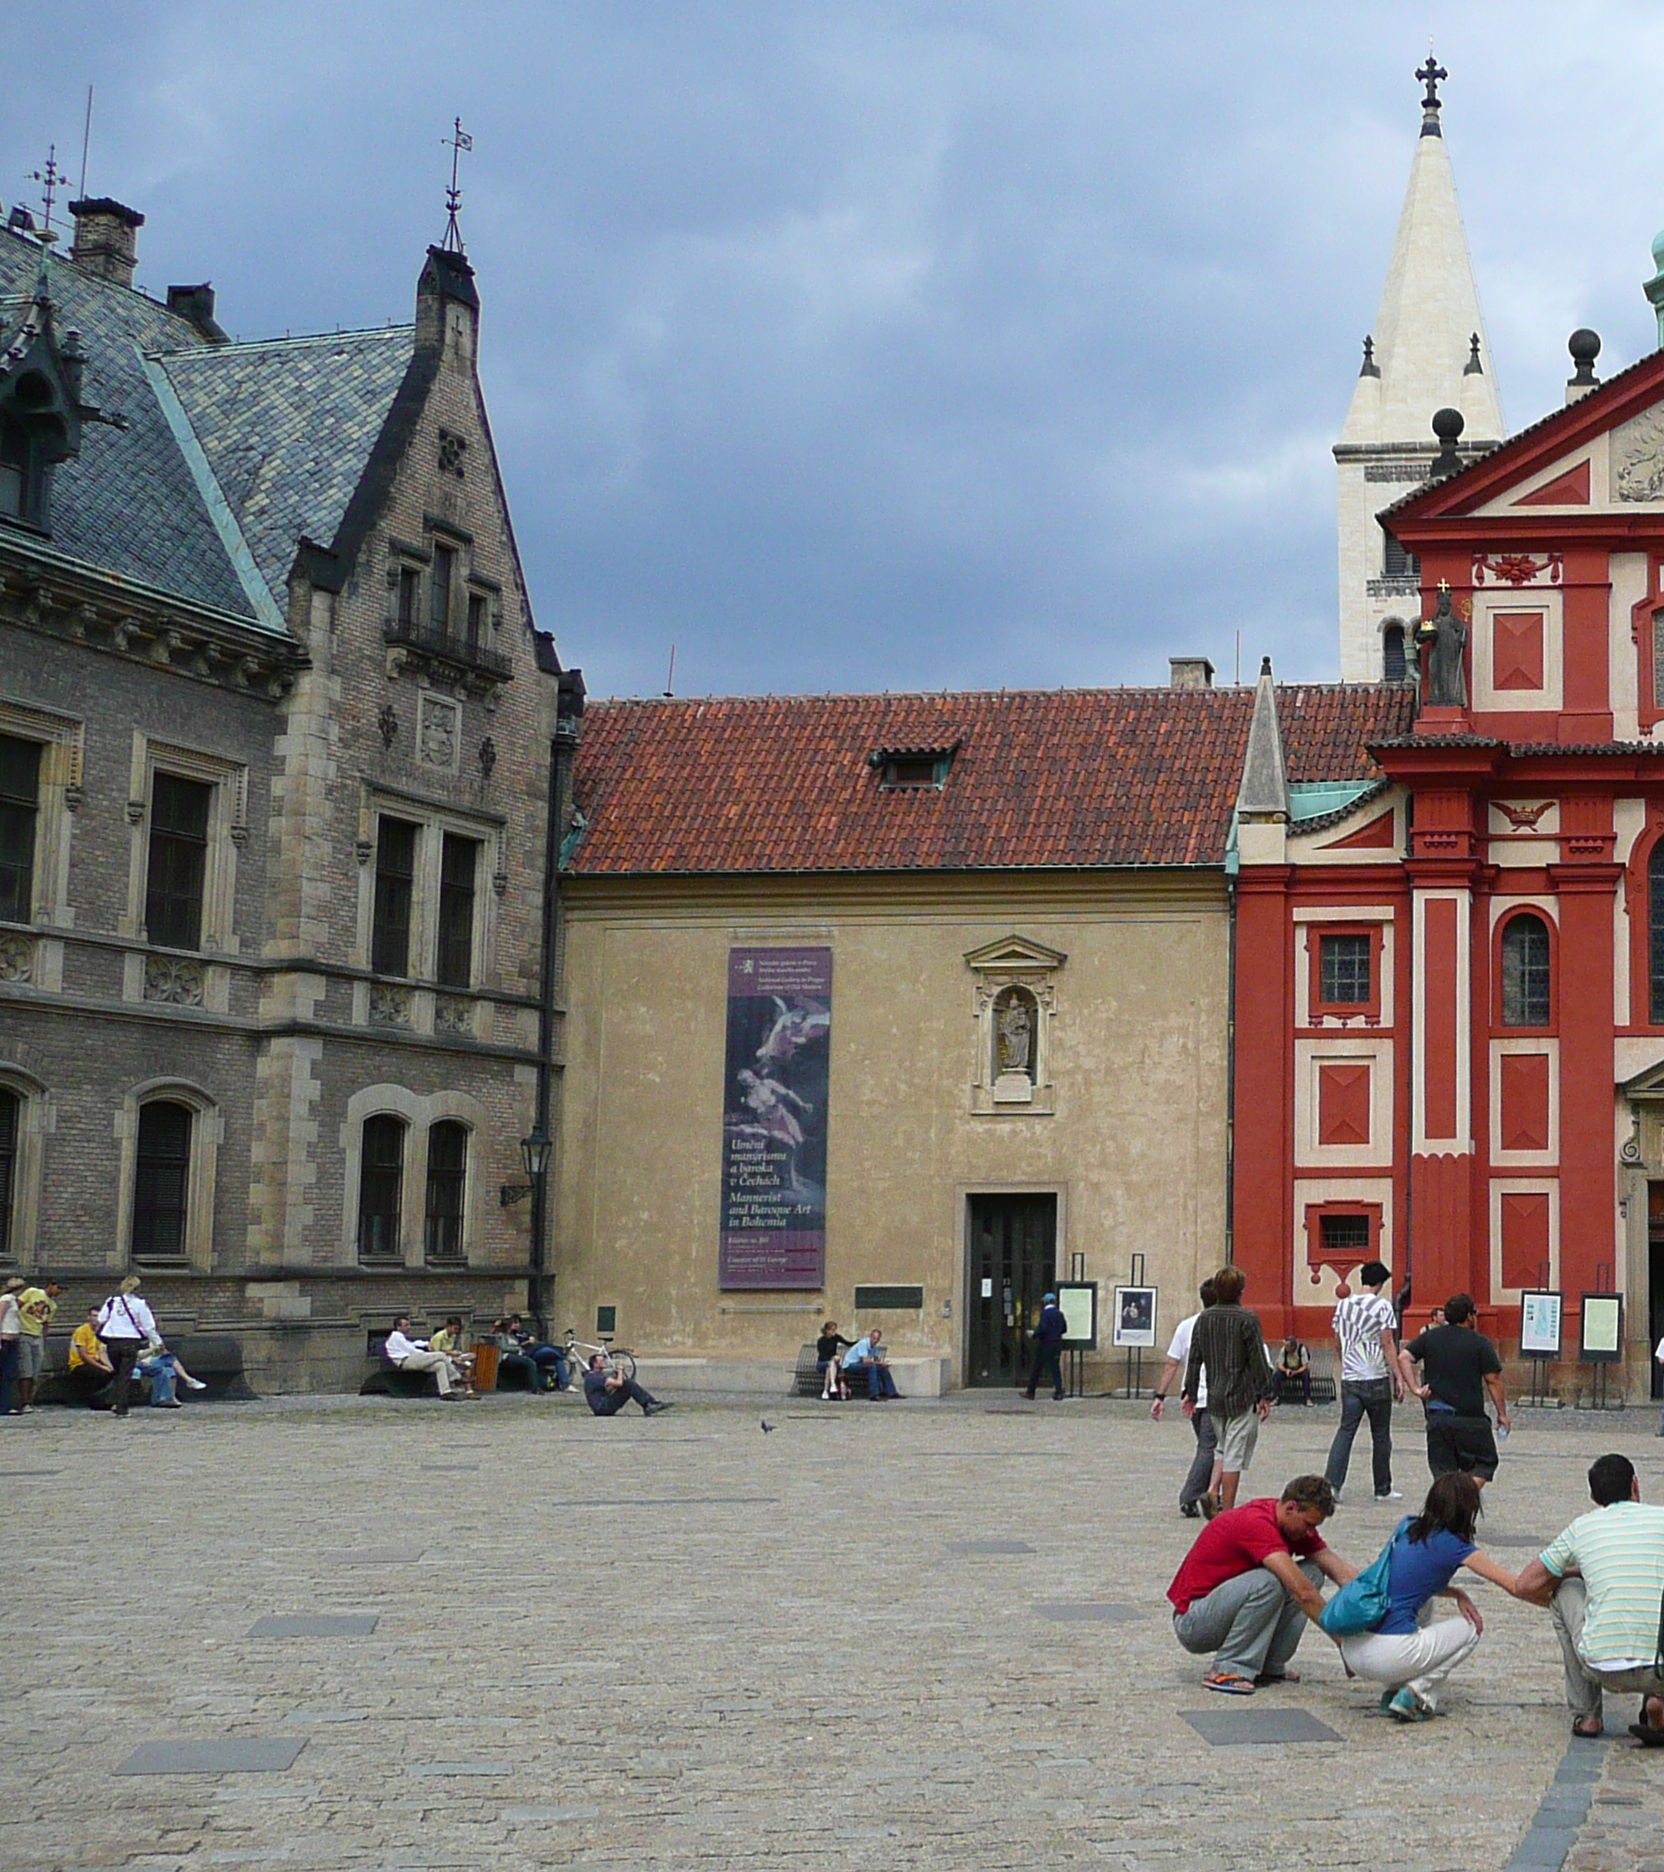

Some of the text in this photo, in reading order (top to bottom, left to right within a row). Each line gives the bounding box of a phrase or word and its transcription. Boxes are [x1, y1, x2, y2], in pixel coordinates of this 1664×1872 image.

[731, 1139, 765, 1150] Umění
[739, 1162, 774, 1173] baroka
[739, 1173, 780, 1186] Čechách
[729, 1192, 781, 1203] Mannerist
[729, 1204, 812, 1217] and Baroque Art
[729, 1216, 787, 1227] in Bohemia
